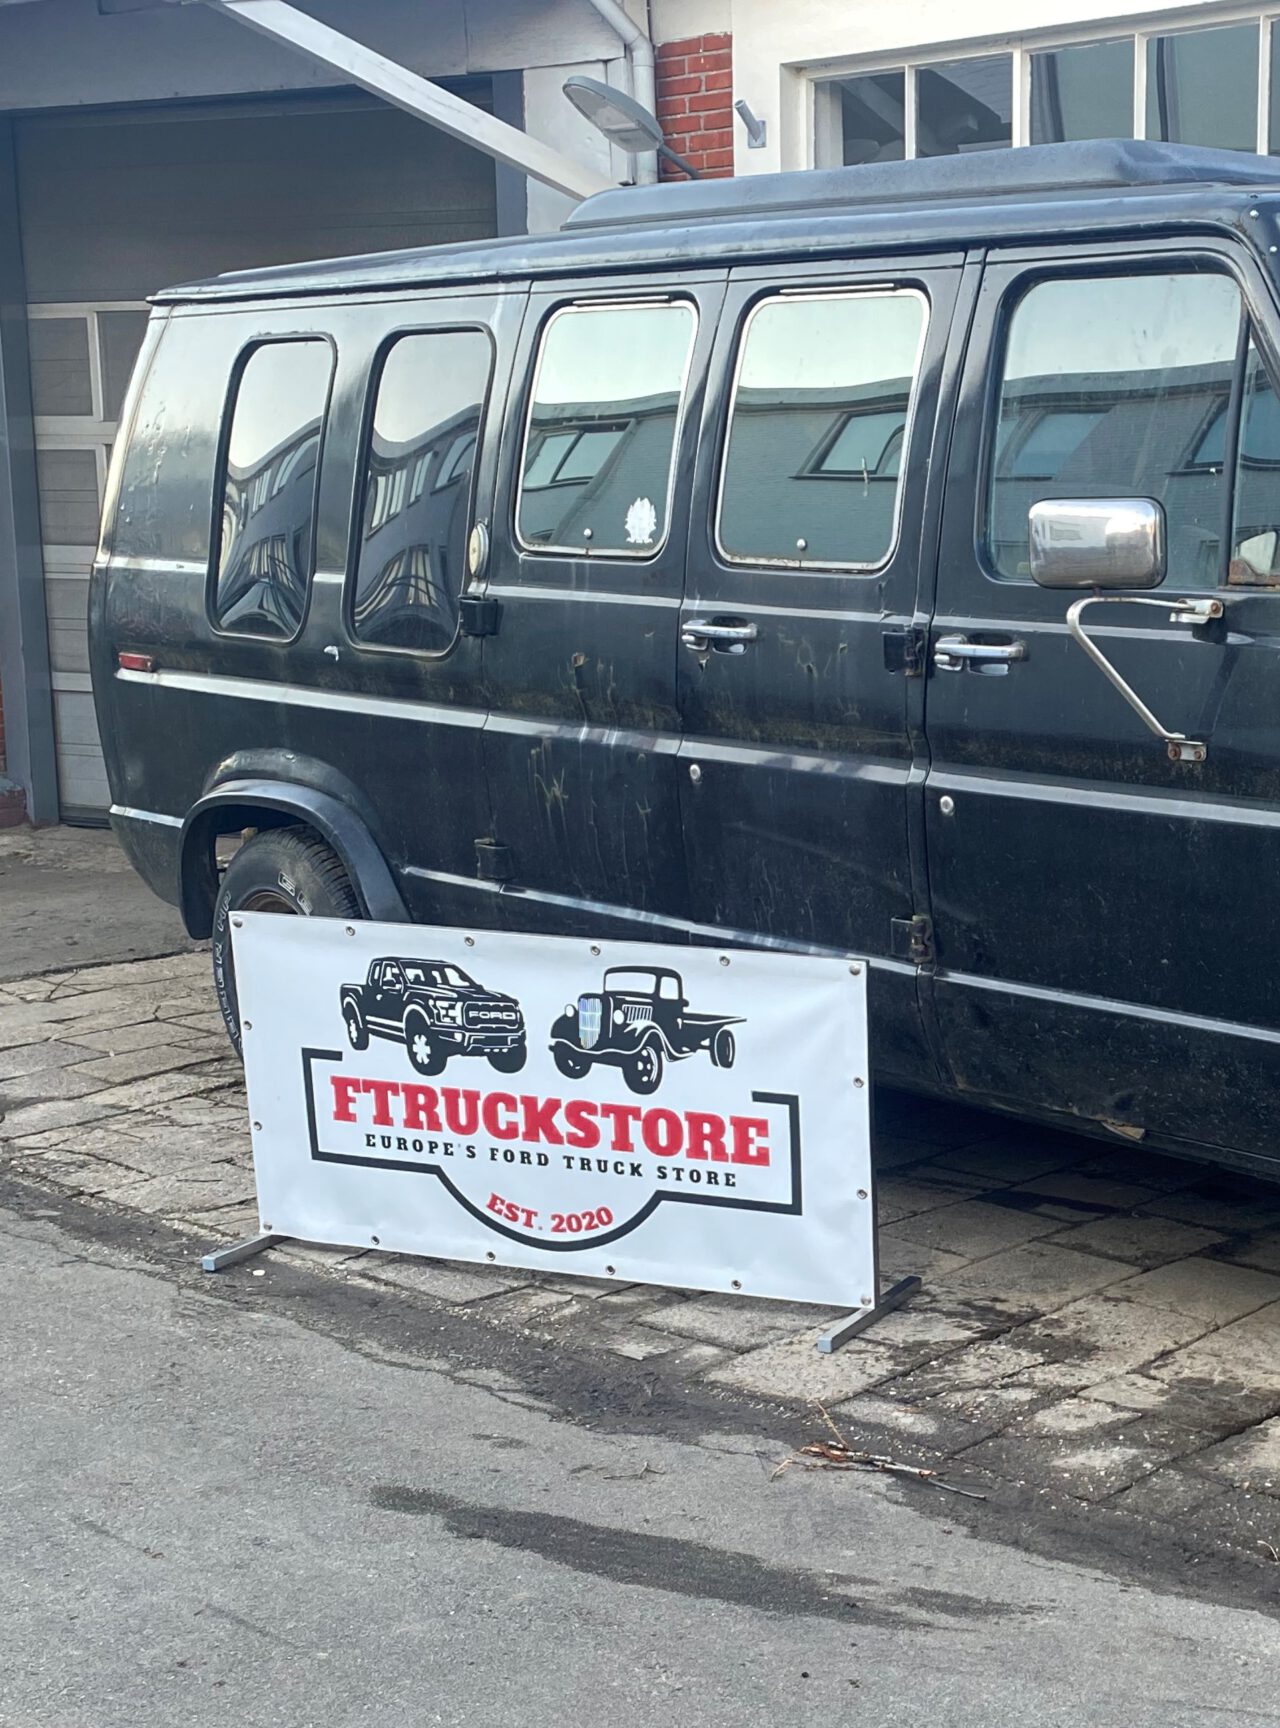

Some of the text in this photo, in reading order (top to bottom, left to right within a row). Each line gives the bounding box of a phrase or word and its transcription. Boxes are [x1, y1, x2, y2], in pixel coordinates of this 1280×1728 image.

[469, 1010, 516, 1020] FORD
[330, 1075, 770, 1167] FTRUCKSTORE
[365, 1133, 736, 1187] EUROPE'S FORD TRUCK STORE
[486, 1192, 613, 1233] EST. 2020
